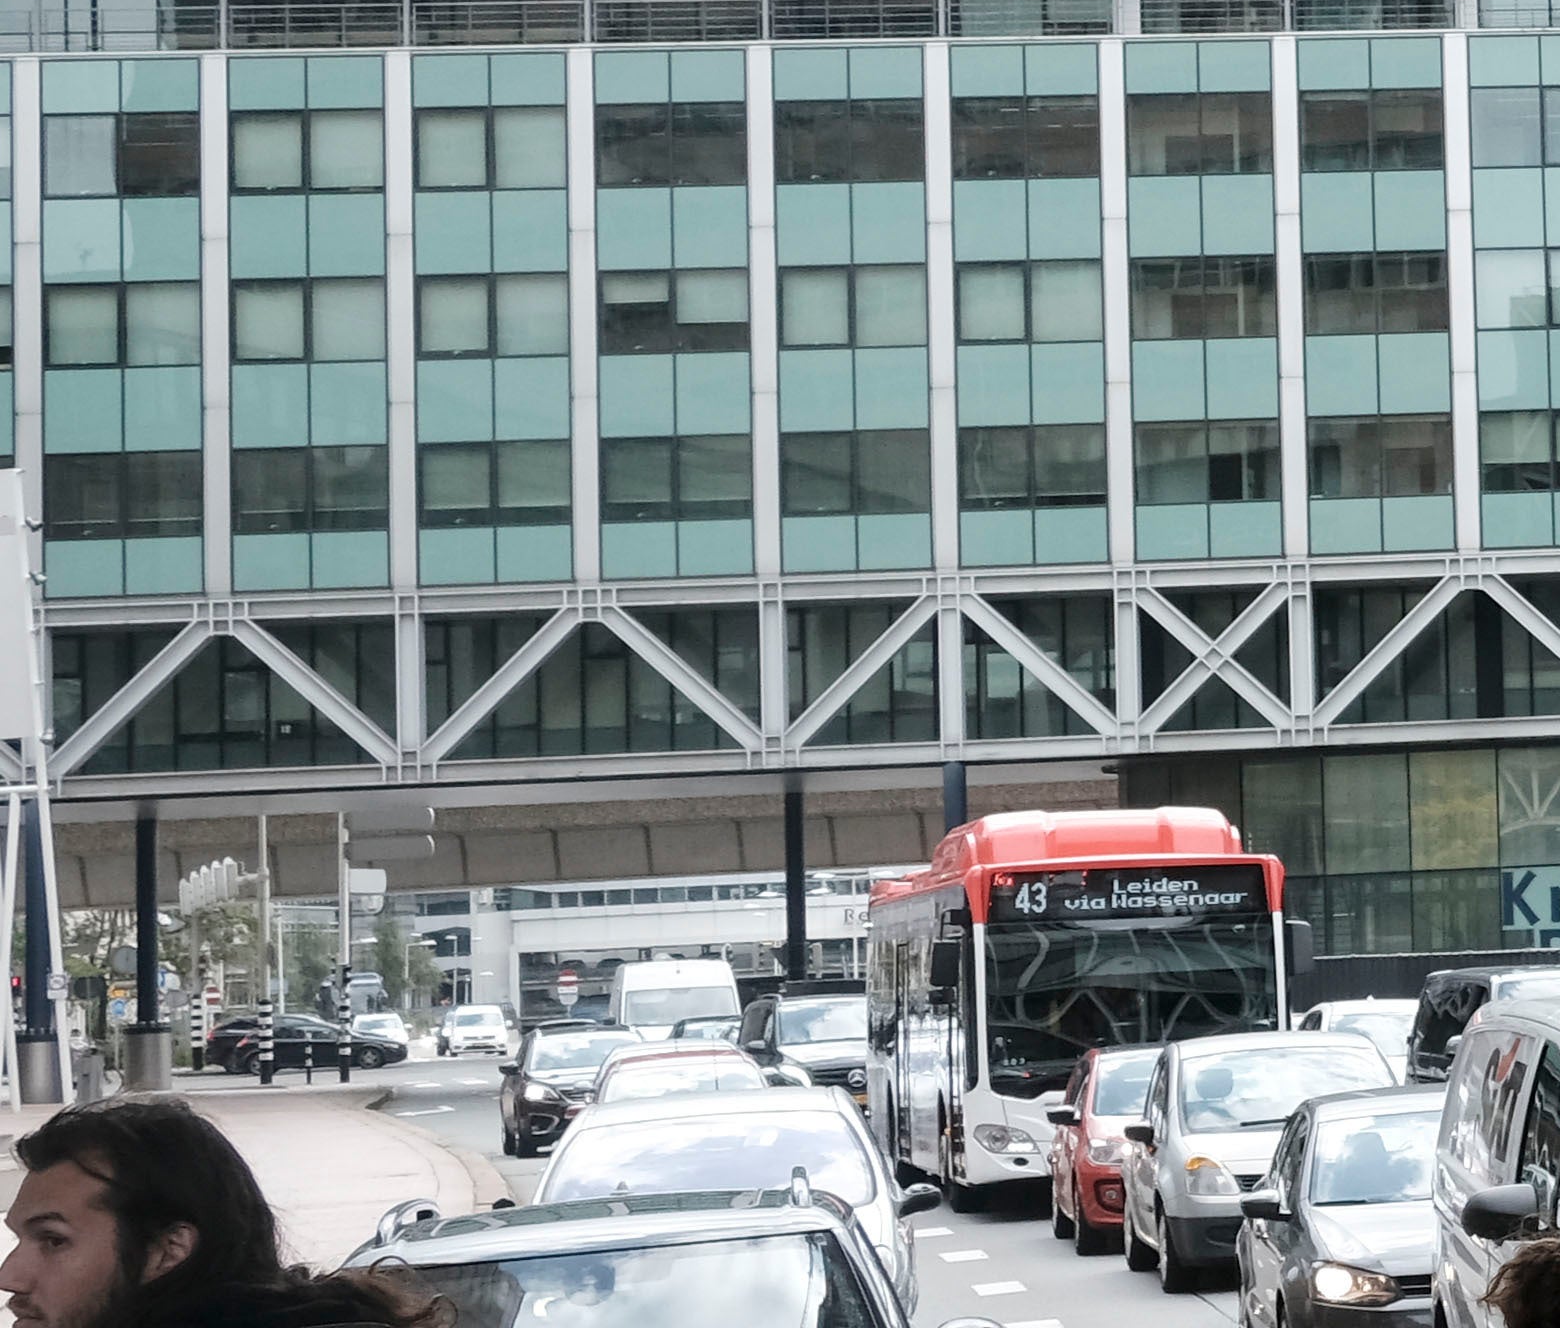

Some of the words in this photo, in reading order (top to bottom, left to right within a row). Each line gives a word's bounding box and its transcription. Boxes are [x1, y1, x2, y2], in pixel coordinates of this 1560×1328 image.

[1112, 877, 1199, 893] Leiden
[1014, 882, 1047, 913] 43
[1064, 895, 1106, 910] via
[1111, 891, 1248, 909] Wassenaar
